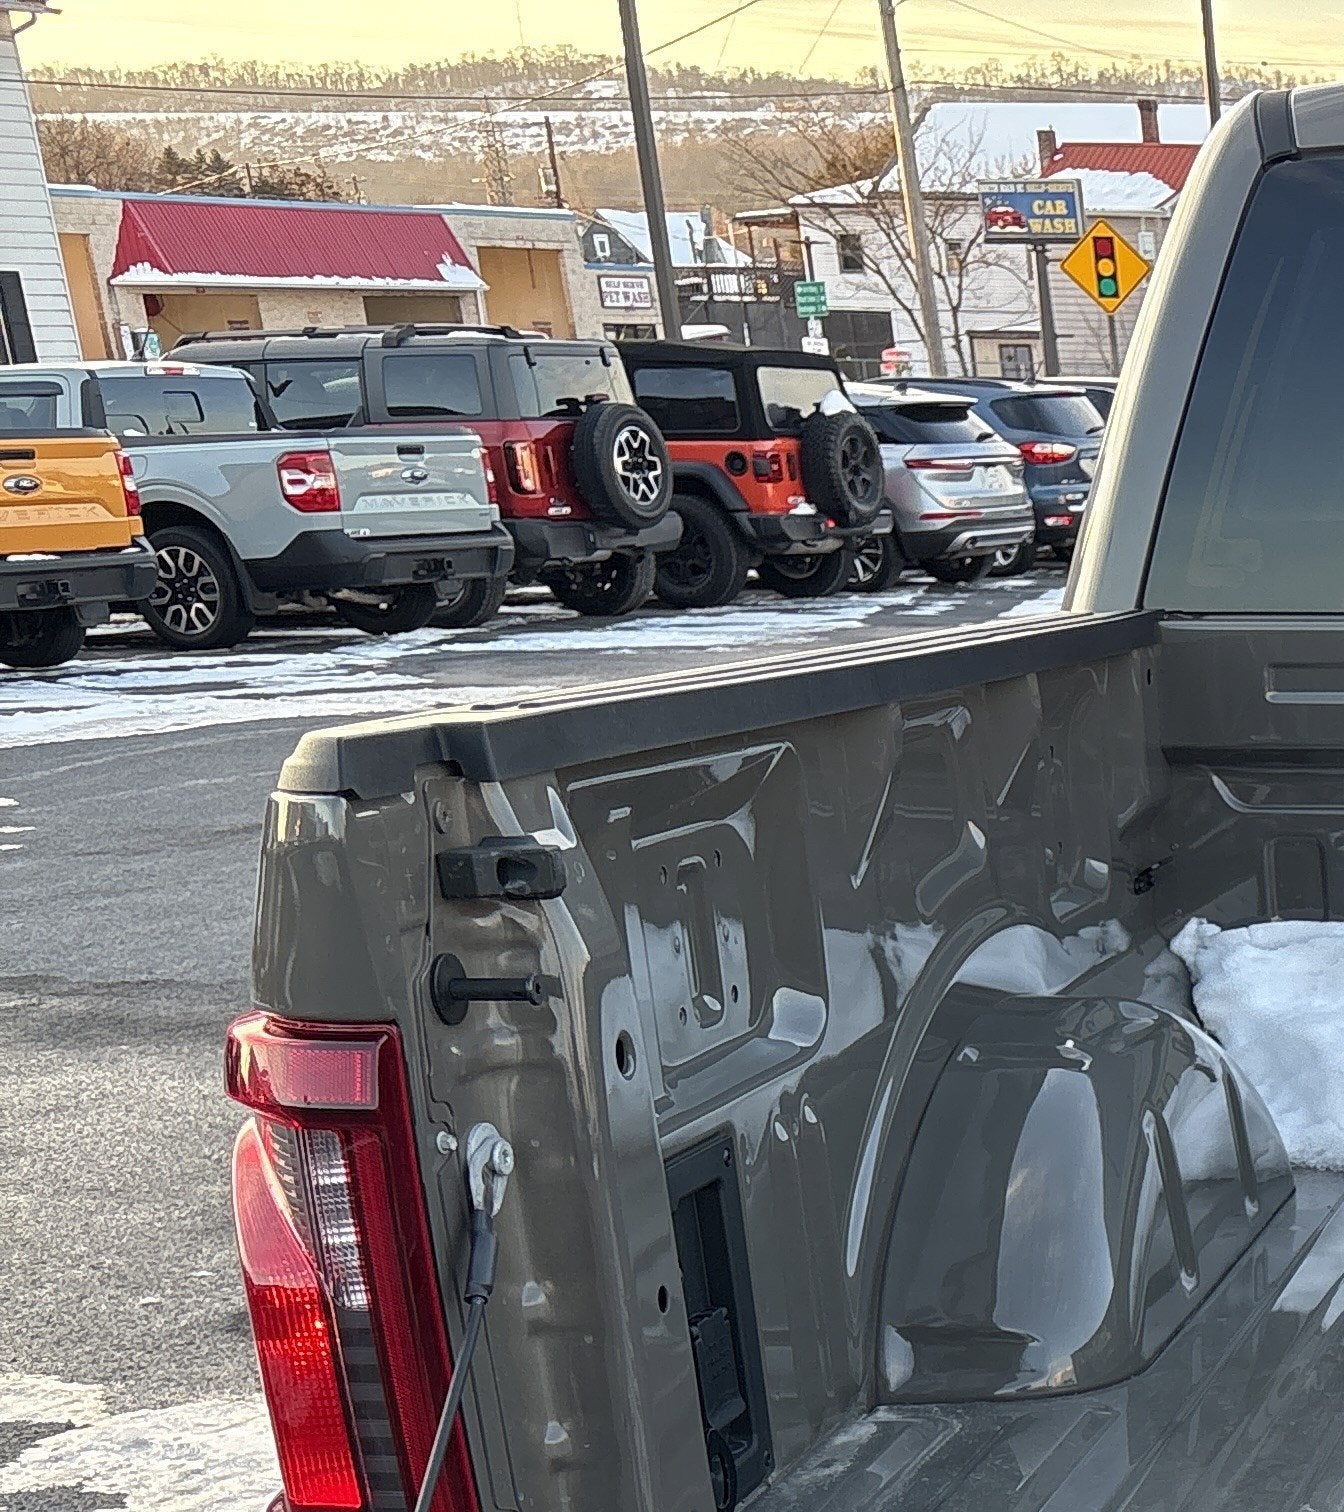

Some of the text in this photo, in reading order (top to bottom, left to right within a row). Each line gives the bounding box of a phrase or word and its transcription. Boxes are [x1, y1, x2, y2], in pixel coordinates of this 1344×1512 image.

[1032, 199, 1068, 216] CAR
[1028, 218, 1076, 233] WASH
[602, 291, 650, 303] PET WASH
[361, 495, 469, 508] MAVERICK
